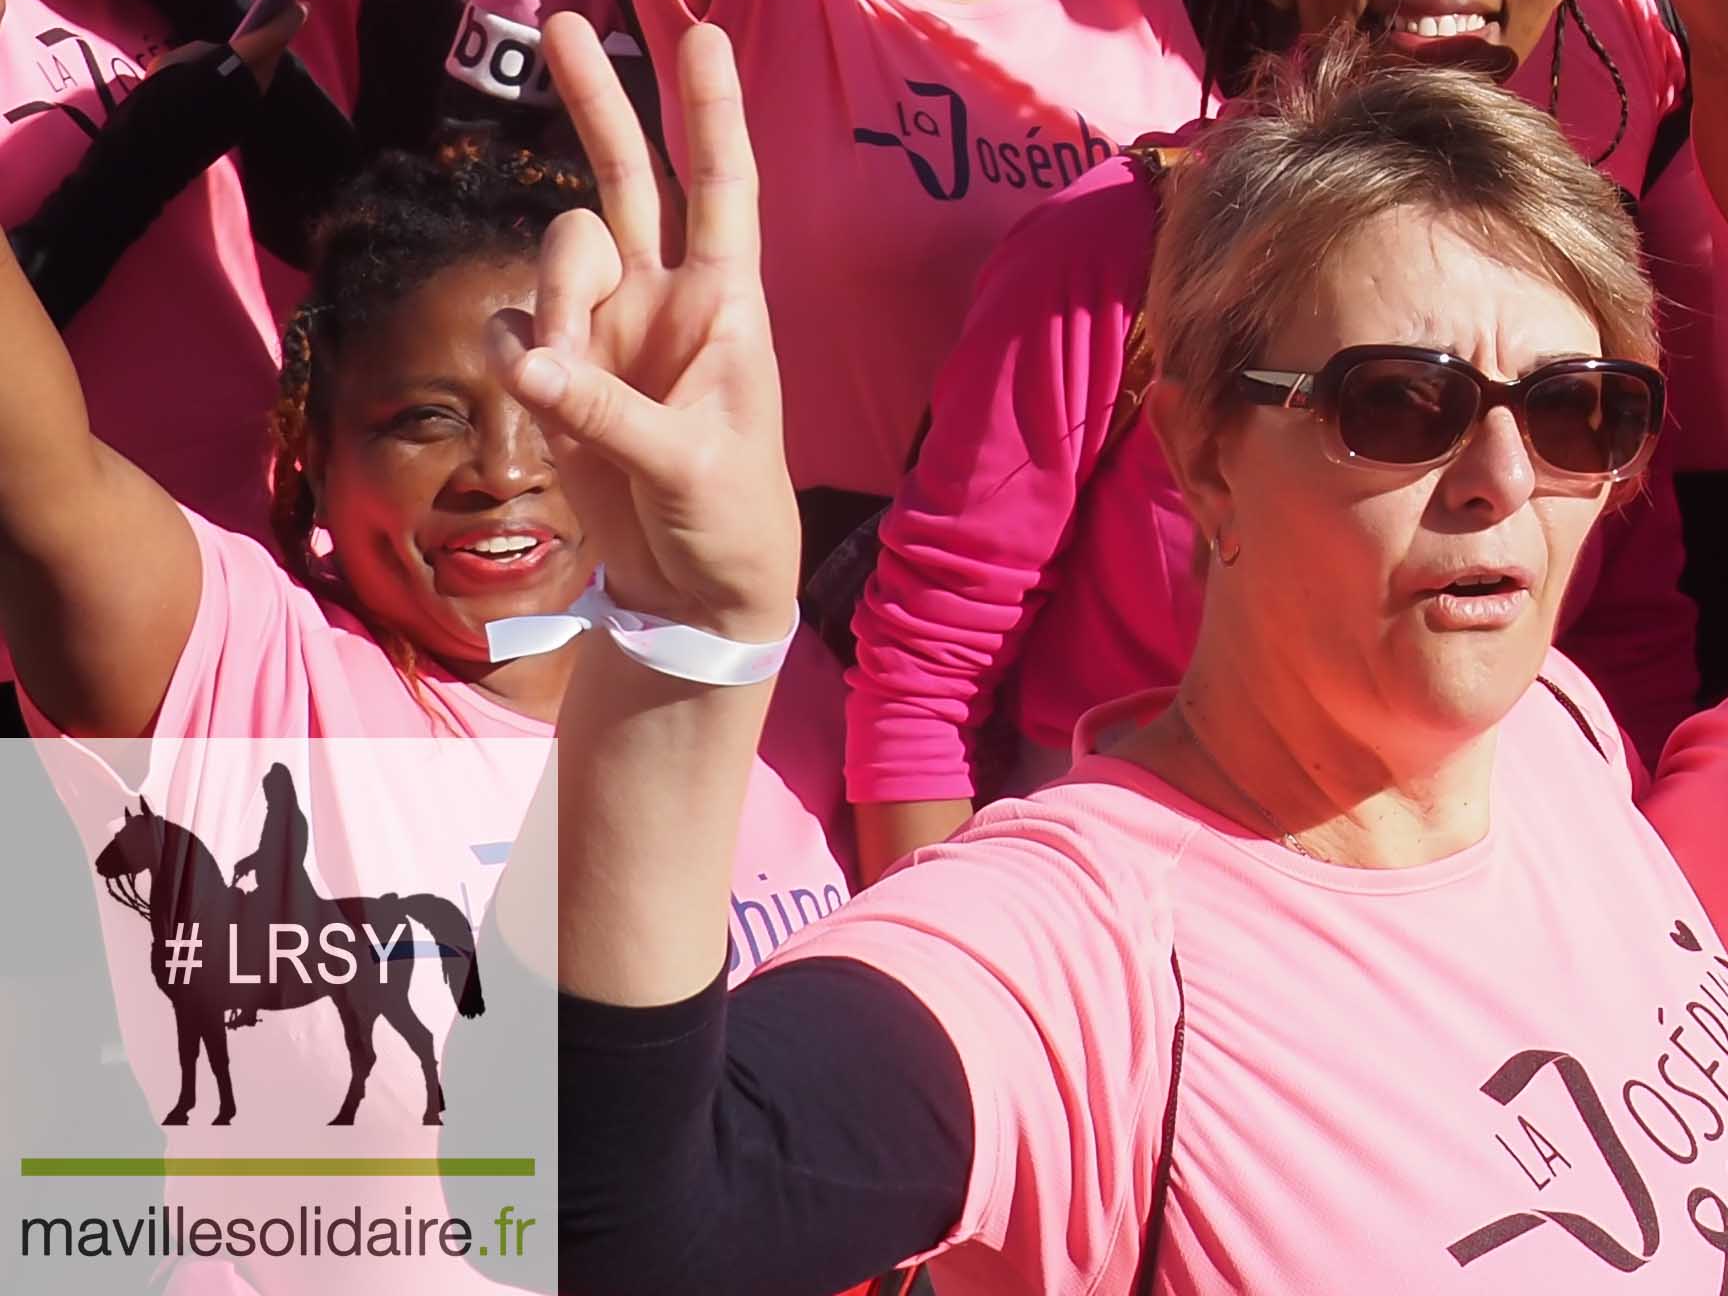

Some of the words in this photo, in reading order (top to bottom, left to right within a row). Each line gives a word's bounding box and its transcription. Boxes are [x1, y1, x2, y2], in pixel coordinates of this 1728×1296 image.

[35, 54, 78, 93] LA
[453, 6, 549, 92] bo
[1495, 1113, 1573, 1192] LA
